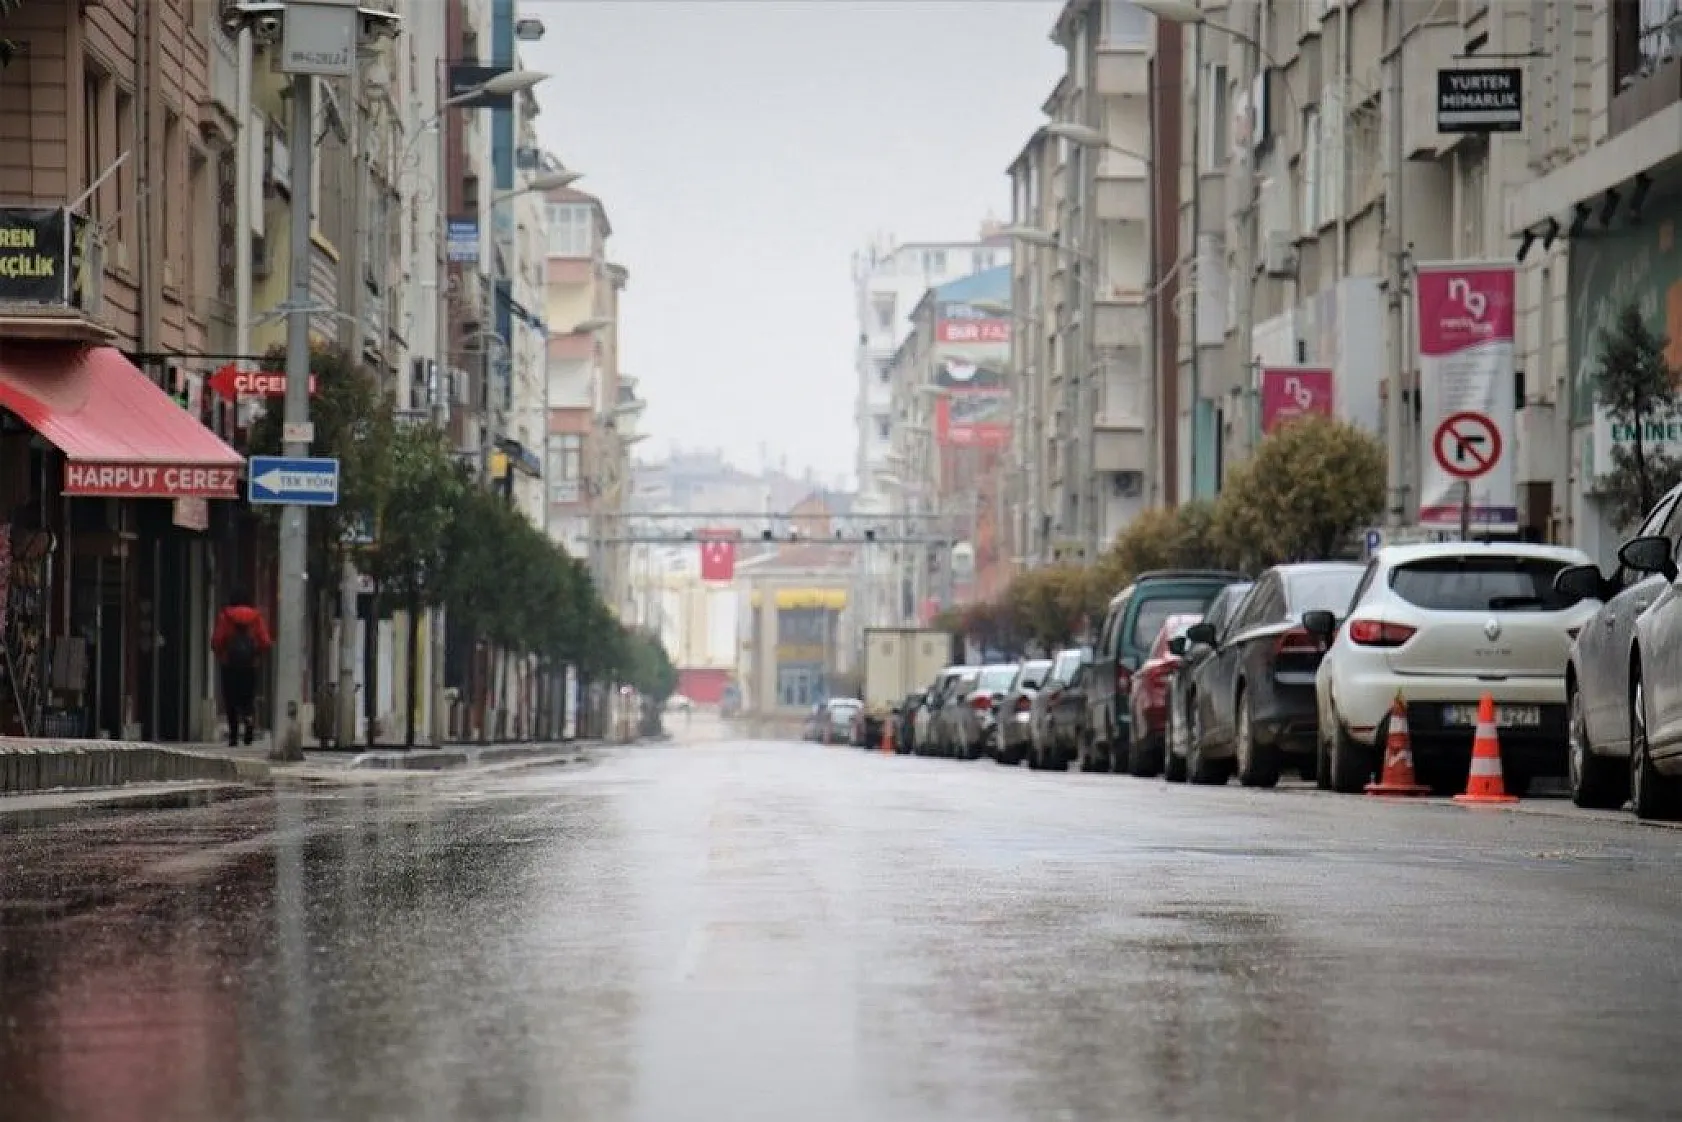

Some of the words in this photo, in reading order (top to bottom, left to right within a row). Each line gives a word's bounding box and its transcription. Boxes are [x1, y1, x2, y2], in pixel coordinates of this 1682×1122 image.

[68, 465, 158, 488] HARPUT
[164, 467, 236, 492] ÇEREZ
[279, 474, 302, 488] TEK
